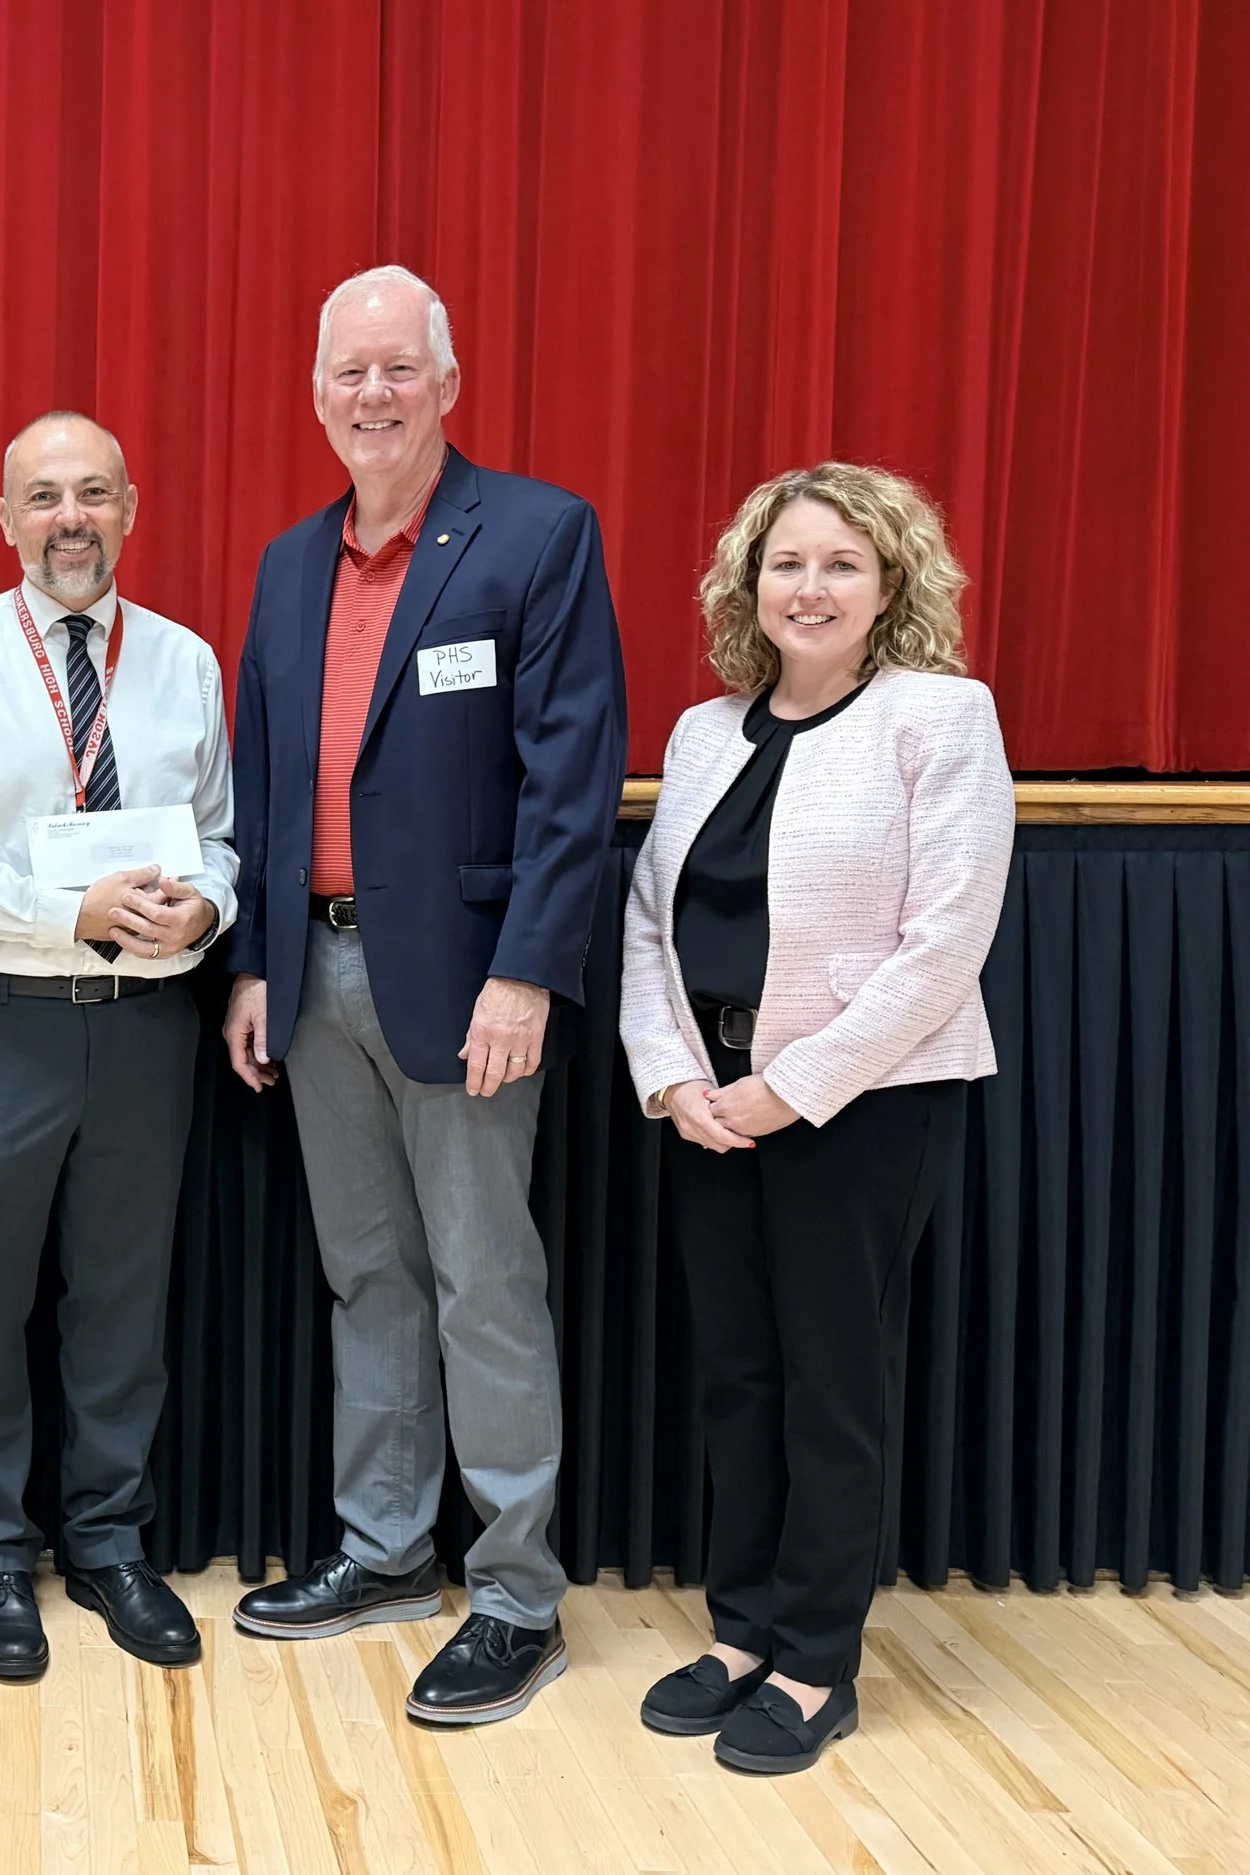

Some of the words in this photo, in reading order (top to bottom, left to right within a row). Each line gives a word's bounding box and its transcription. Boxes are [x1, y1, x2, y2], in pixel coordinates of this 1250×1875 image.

[432, 646, 473, 666] PHS
[15, 587, 45, 659] ARKERSBURG
[40, 664, 59, 694] HIGH
[54, 700, 74, 754] SCHOOL
[430, 670, 483, 689] Visitor
